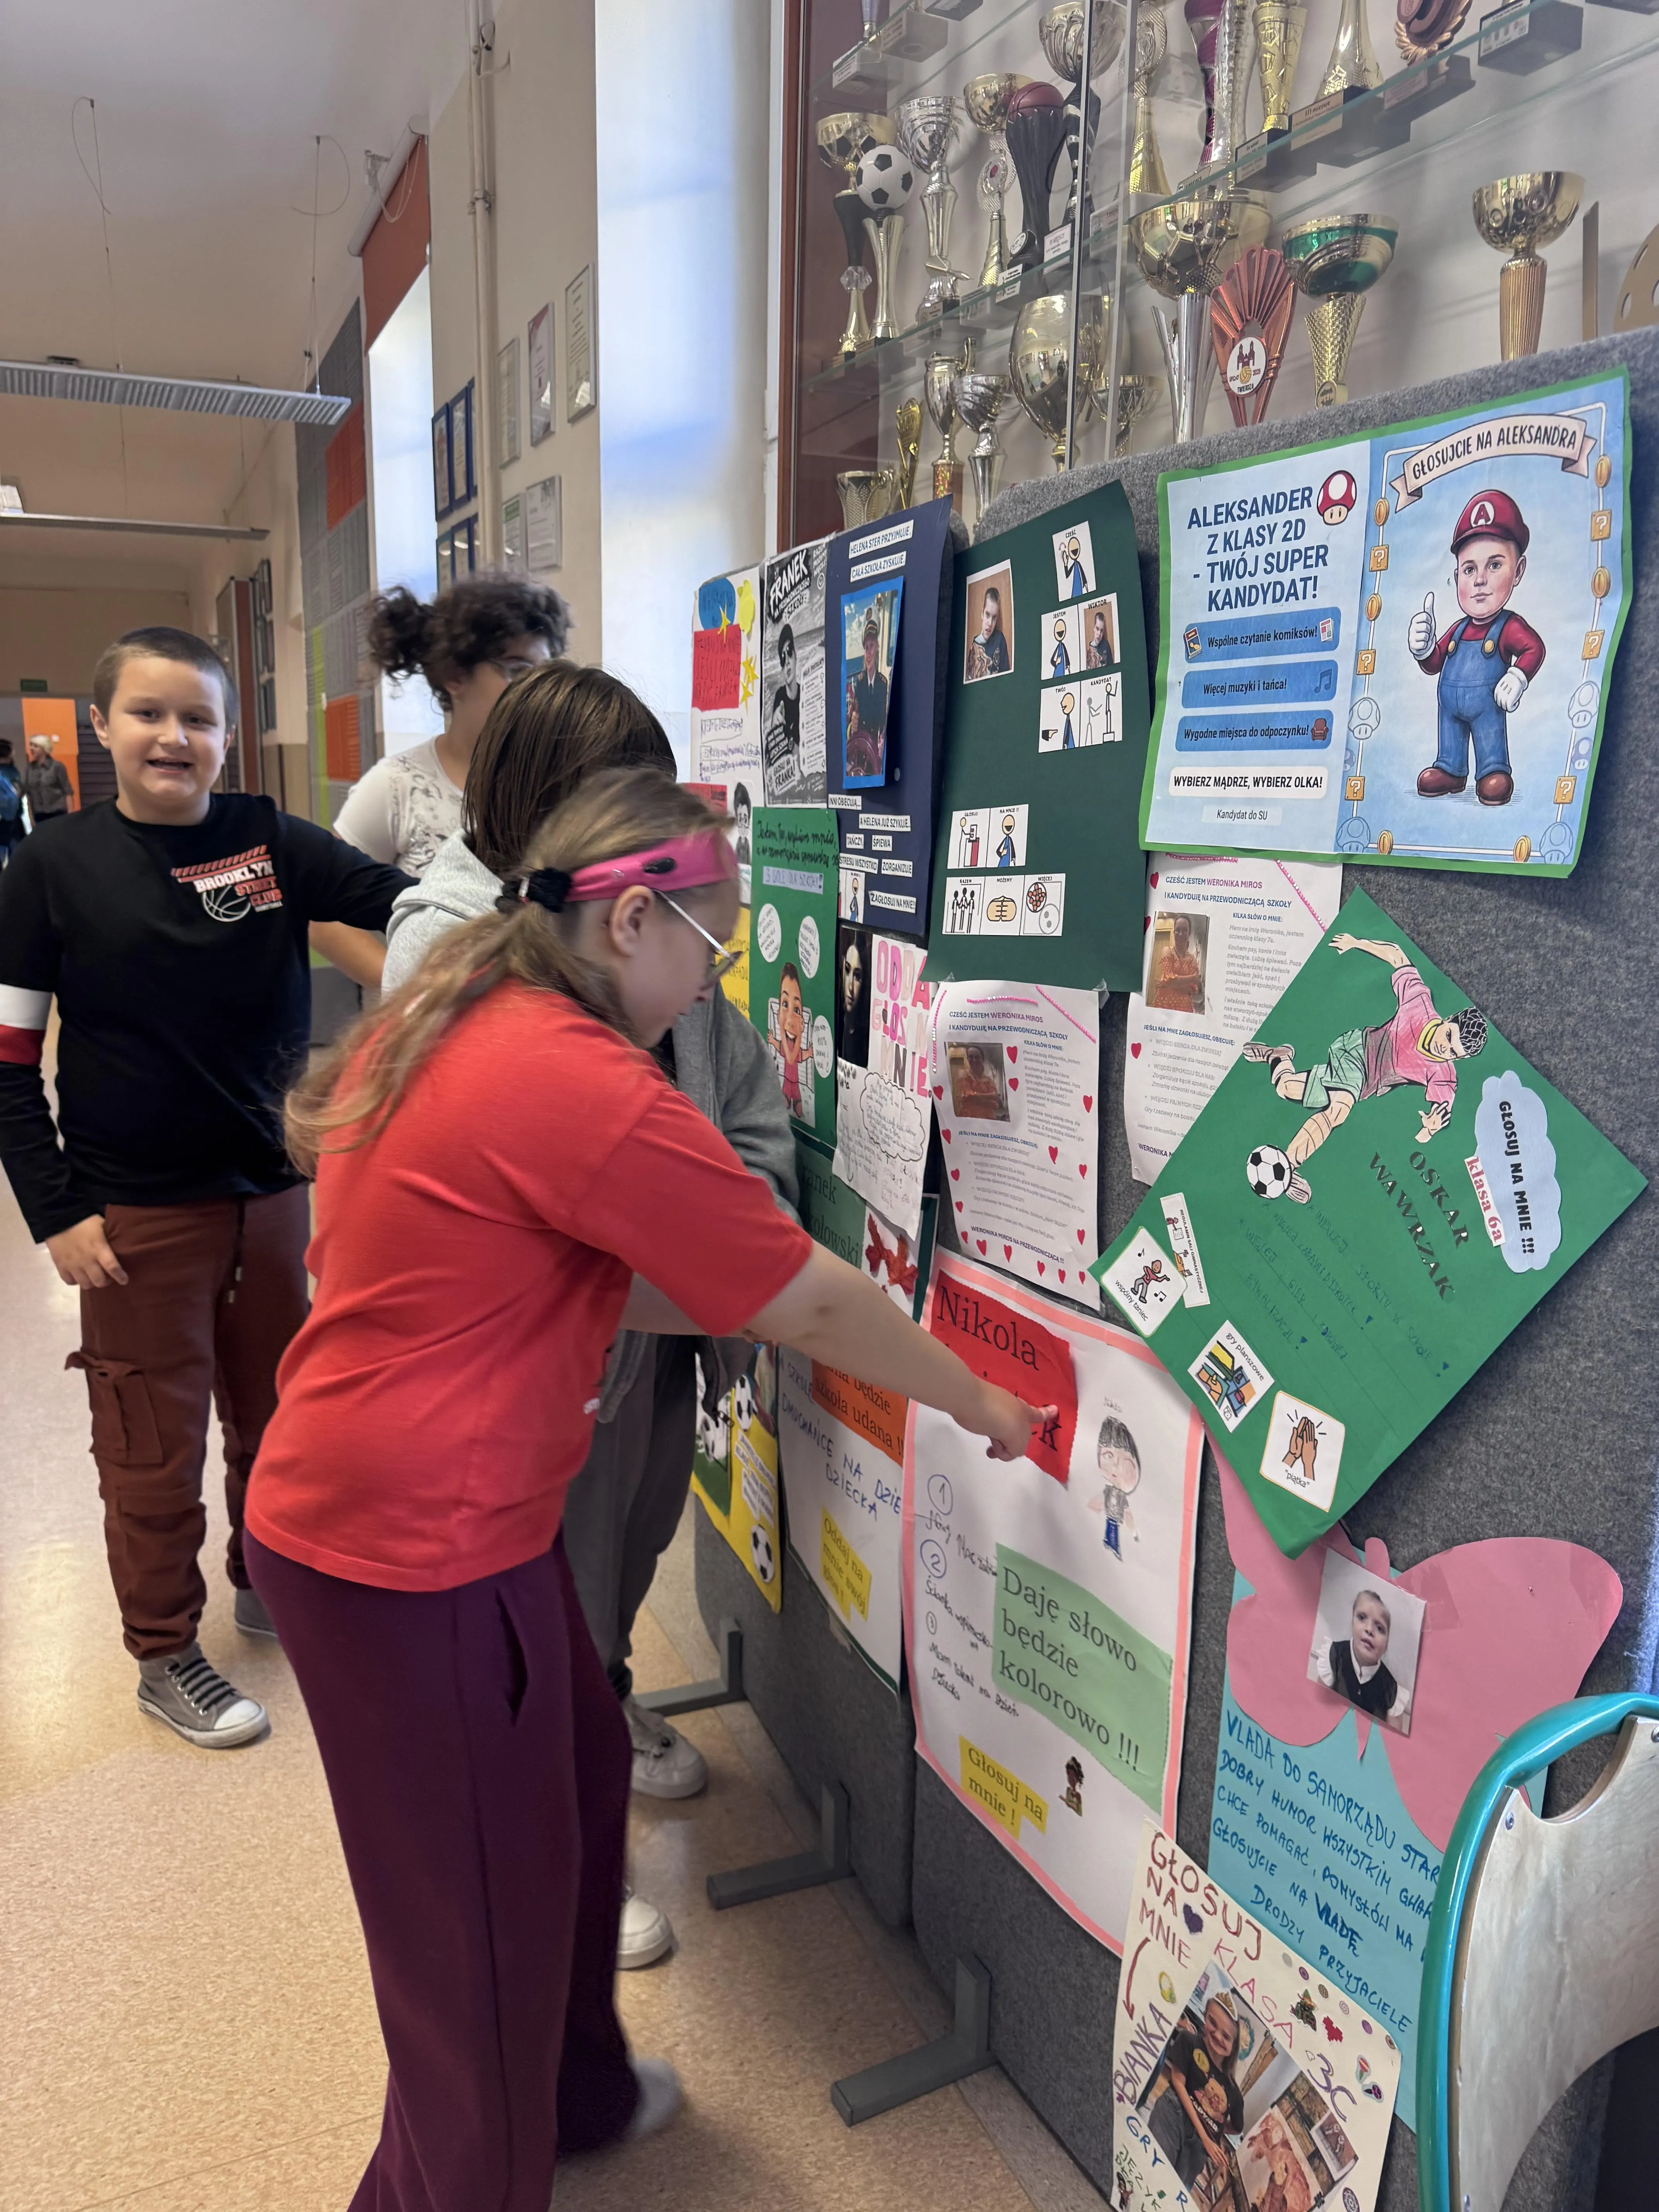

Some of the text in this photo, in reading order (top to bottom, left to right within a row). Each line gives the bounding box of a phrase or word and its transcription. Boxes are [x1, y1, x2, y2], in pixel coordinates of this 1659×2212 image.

[1413, 424, 1577, 480] GŁOSUJCIE NA ALEKSANDRA
[1187, 486, 1313, 529] ALEKSANDER
[850, 536, 880, 554] HELENA STER
[1207, 519, 1305, 555] Z KLASY 2D
[770, 548, 808, 617] FRANEK
[852, 565, 864, 578] CAŁA
[865, 560, 882, 574] SZKOŁA
[1207, 544, 1329, 583] TWÓJ SUPER
[1088, 599, 1107, 609] WIKTOR
[1208, 575, 1317, 612] KANDYDAT!
[1208, 625, 1317, 649] Wspólne czytanie komiksów!
[1091, 677, 1111, 686] KANDYDAT
[1203, 678, 1287, 696] Więcej muzyki i tańca!
[1184, 725, 1309, 742] Wygodne miejsca do odpoczynku!
[1174, 776, 1322, 789] WYBIERZ MĄDRZE, WYBIERZ OLKA!
[864, 817, 880, 826] HELENA
[881, 818, 890, 828] JUŻ
[1217, 809, 1267, 821] Kandydat do SU
[873, 837, 891, 848] ŚPIEWA
[193, 860, 275, 893] BROOKLYN
[855, 859, 877, 871] WSZYSTKO
[883, 862, 912, 874] ZORGANIZUJE
[1166, 876, 1185, 884] CZEŚĆ
[1207, 878, 1239, 888] WERONIKA
[1240, 880, 1262, 889] MIROS
[871, 893, 902, 907] ZAGŁOSUJ NA
[1167, 893, 1200, 902] KANDYDUJĘ
[1210, 895, 1264, 907] PRZEWODNICZĄCĄ
[1267, 899, 1291, 908] SZKOŁY
[1247, 912, 1262, 921] SŁÓW
[998, 1026, 1048, 1038] PRZEWODNICZĄCĄ
[1049, 1032, 1068, 1040] SZKOŁY
[1026, 1015, 1043, 1023] MIROS
[1139, 1143, 1167, 1157] WERONIKA
[1499, 1101, 1535, 1254] GŁOSUJ NA MNIE !!!
[1409, 1152, 1469, 1249] OSKAR
[1468, 1156, 1503, 1243] klasa 6a
[971, 1226, 998, 1238] WERONIKA
[998, 1233, 1012, 1242] MIROS
[1369, 1152, 1455, 1300] WAWRZAK
[1180, 1209, 1190, 1239] REGULAMIN
[1191, 1251, 1203, 1293] GIMNASTYCZNEJ
[1115, 1280, 1149, 1322] wspólny taniec
[937, 1286, 1039, 1370] Nikola
[1226, 1333, 1264, 1382] gry planszowe
[852, 1406, 893, 1450] udana
[843, 1453, 862, 1482] NA
[826, 1463, 878, 1522] DZIECKA
[824, 1518, 863, 1583] Oddaj na
[1003, 1567, 1137, 1671] Daję słowo
[1002, 1608, 1078, 1677] będzie
[1000, 1650, 1139, 1771] kolorowo !!!
[969, 1747, 1043, 1822] Głosuj na
[969, 1776, 1015, 1825] mnie !
[1227, 1709, 1395, 1849] VLADA DO SAMORZĄDU
[1219, 1750, 1391, 1894] DOBRY HUMOR WSZYSTKIM
[1213, 1817, 1277, 1876] GŁOSUJCIE
[1290, 1882, 1308, 1906] NA
[1218, 1786, 1413, 1951] CHCE POMAGAĆ POMYSŁÓW MA
[1147, 1867, 1178, 1917] NA
[1151, 1832, 1262, 1961] GŁOSUJ
[1140, 1899, 1190, 1968] MNIE
[1251, 1884, 1412, 2032] DRODZY PRZYJACIELE
[1214, 1938, 1357, 2123] KLASA 3C
[1114, 2003, 1172, 2106] BIANKA
[1127, 2116, 1165, 2167] GRY
